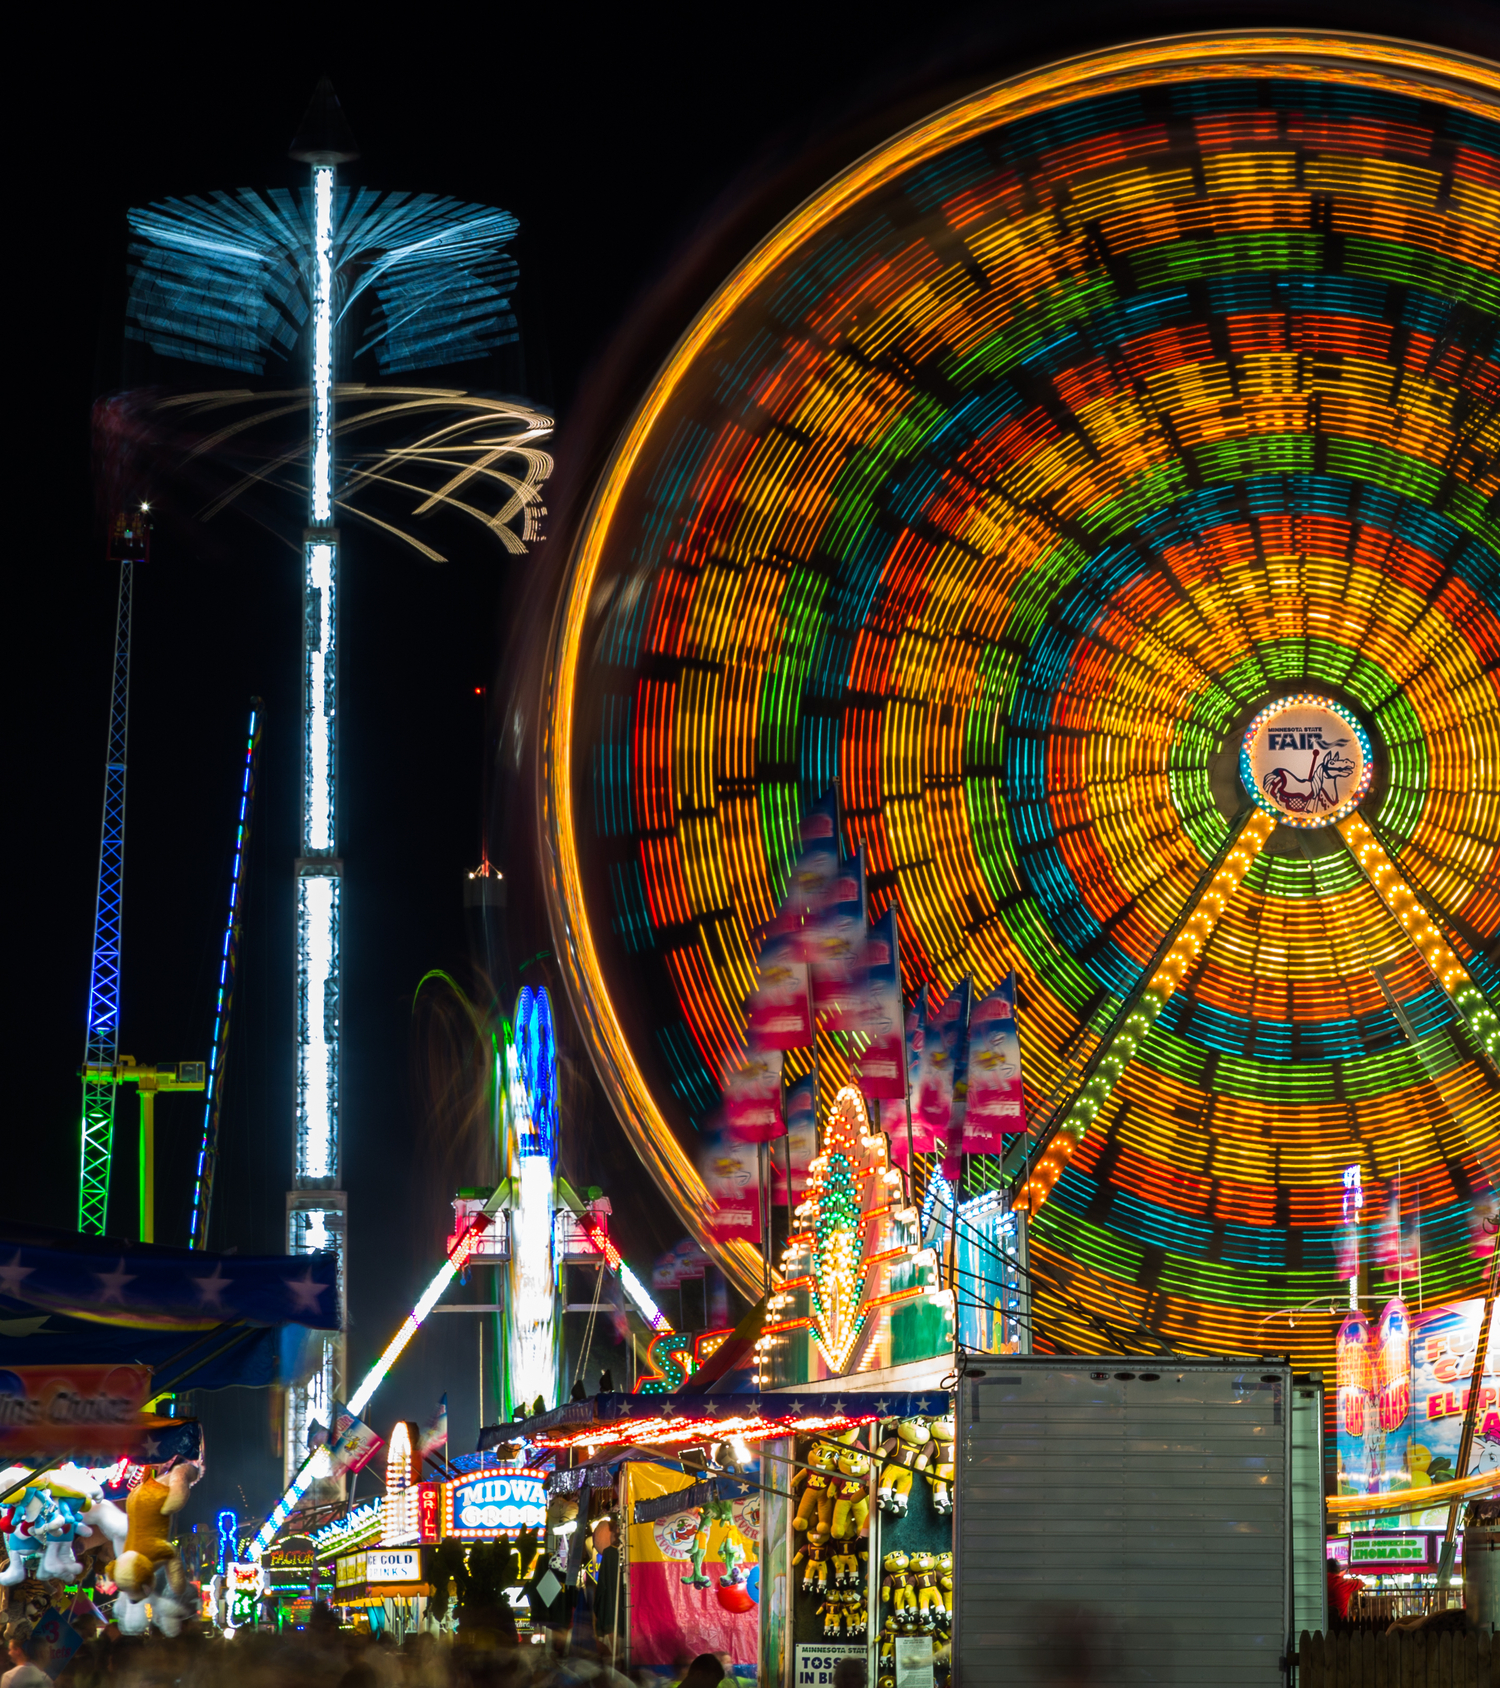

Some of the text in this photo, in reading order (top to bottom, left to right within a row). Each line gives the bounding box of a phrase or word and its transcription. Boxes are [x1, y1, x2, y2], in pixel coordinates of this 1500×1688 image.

[1268, 733, 1335, 750] FAIR
[456, 1479, 547, 1506] MIDWA
[422, 1490, 437, 1537] GRILL
[462, 1506, 546, 1526] GRIL
[734, 1514, 759, 1541] EVER
[655, 1534, 686, 1559] EVERY
[1353, 1540, 1370, 1548] FRESH
[270, 1550, 315, 1566] FACTOR
[380, 1554, 413, 1565] COLD
[1352, 1548, 1423, 1560] LEMONADE
[802, 1656, 842, 1669] TOSS
[800, 1672, 833, 1684] IN BI
